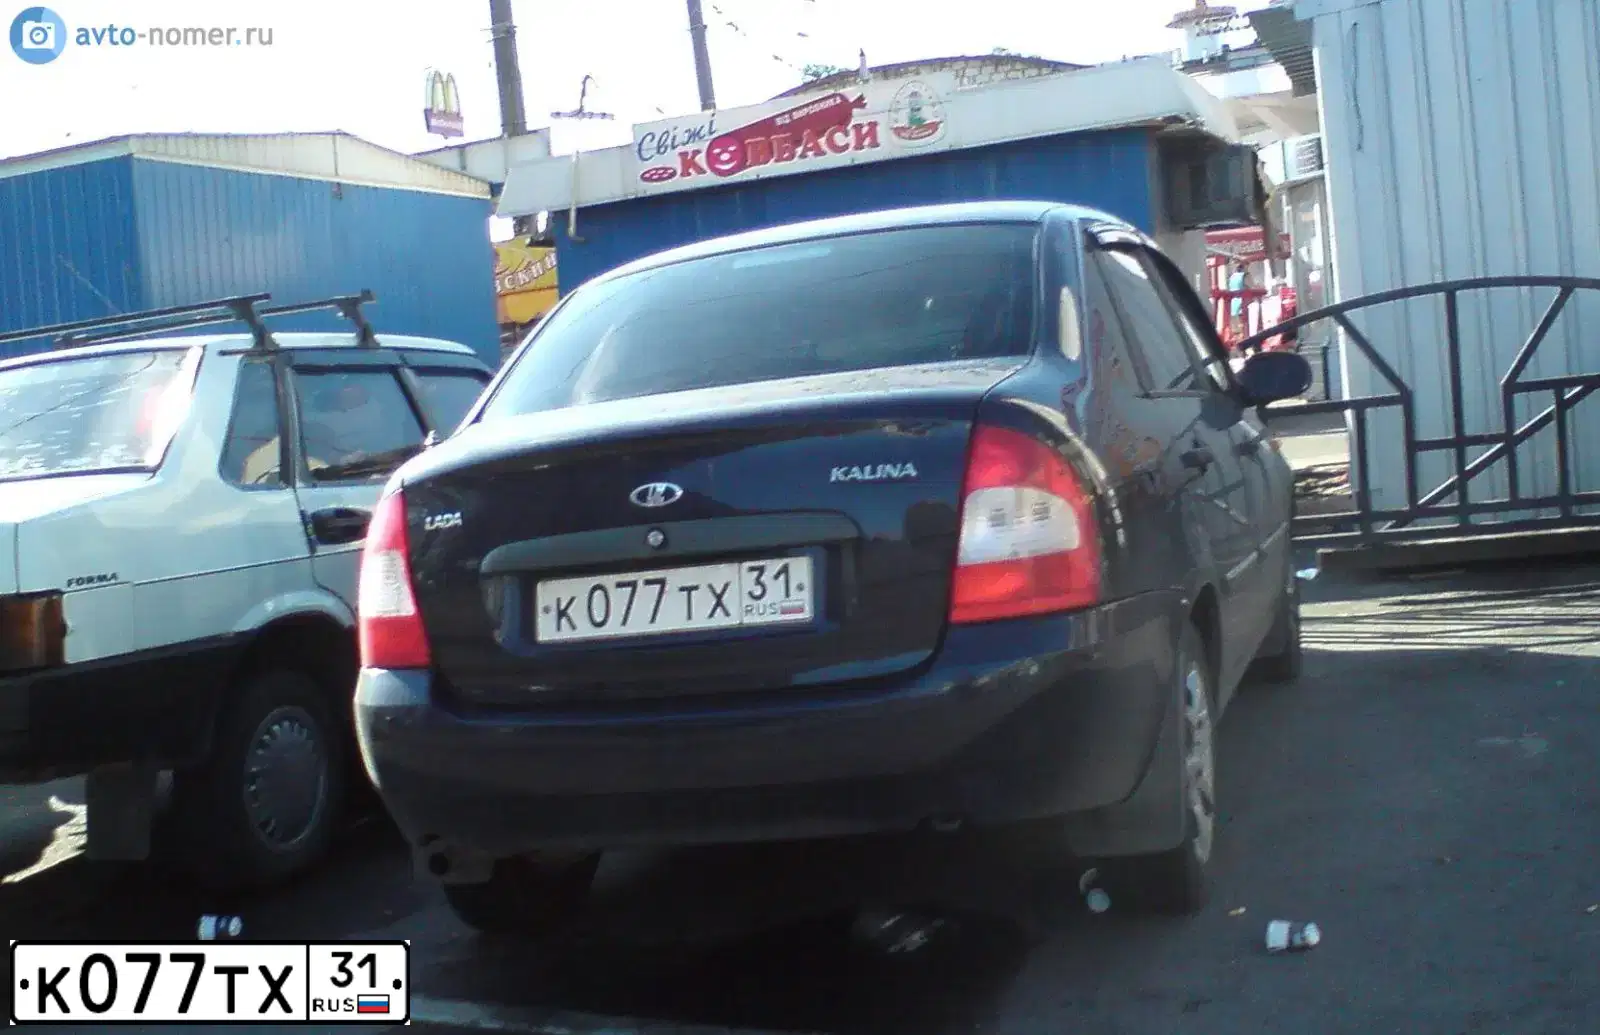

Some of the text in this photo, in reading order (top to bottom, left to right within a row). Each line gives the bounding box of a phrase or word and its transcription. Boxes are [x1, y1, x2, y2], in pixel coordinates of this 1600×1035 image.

[829, 462, 918, 482] KALINA
[424, 511, 462, 530] LADA
[66, 572, 118, 588] FORMA
[747, 562, 791, 601] 31
[744, 602, 778, 616] RUS
